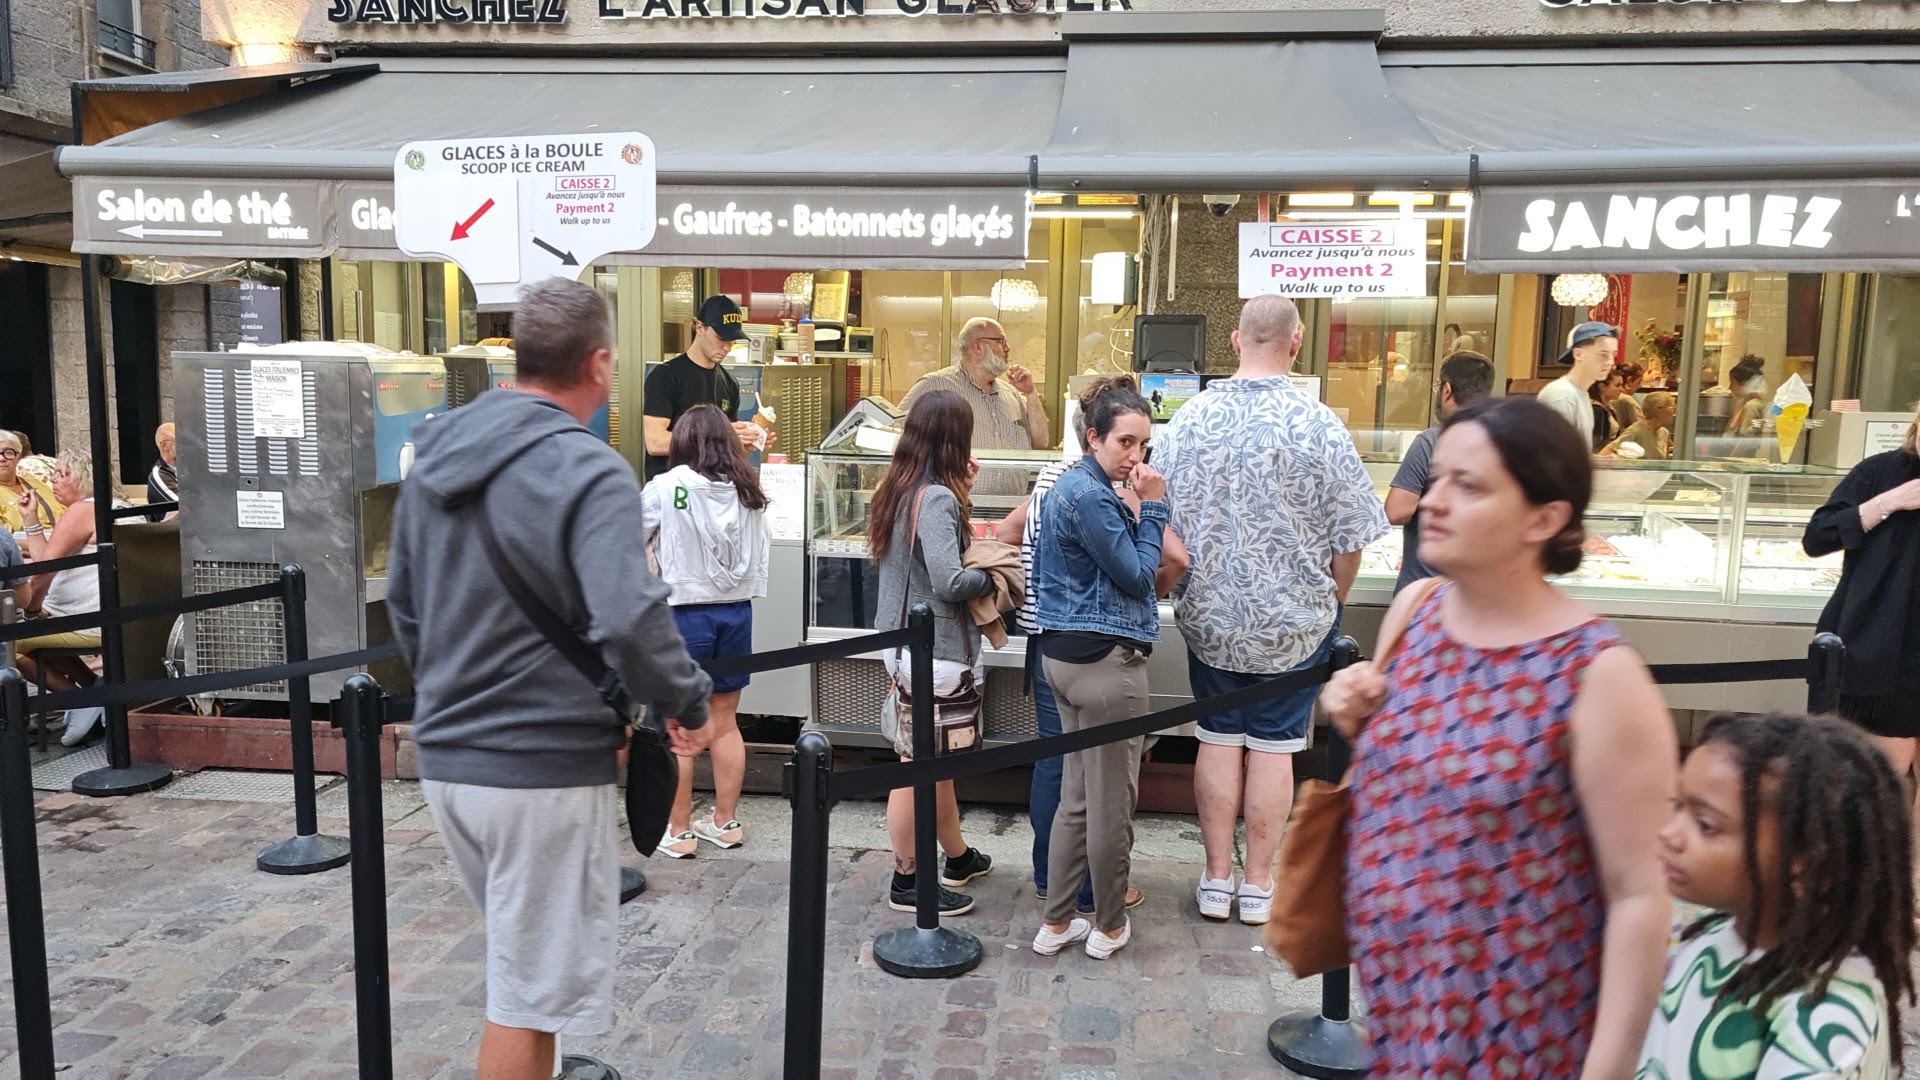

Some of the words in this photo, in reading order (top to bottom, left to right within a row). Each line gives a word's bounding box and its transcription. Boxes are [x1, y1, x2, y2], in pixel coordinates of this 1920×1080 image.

[328, 0, 567, 24] SANCHEZ
[599, 0, 865, 18] LARISAN
[442, 145, 505, 161] GLACES
[511, 145, 520, 159] à
[526, 144, 540, 159] la
[546, 143, 603, 158] BOULE
[461, 162, 507, 174] SCOOP
[511, 161, 532, 173] ICE
[535, 161, 585, 172] CREAM
[561, 178, 601, 189] CAISSE
[603, 178, 610, 188] 2
[546, 191, 577, 200] Avancez
[578, 190, 606, 200] jusqu'à
[607, 191, 625, 199] nous
[98, 189, 186, 222] Salon
[192, 190, 232, 223] de
[238, 191, 292, 224] thé
[556, 203, 605, 215] Payment
[608, 202, 615, 212] 2
[560, 217, 579, 225] Walk
[581, 218, 591, 226] up
[673, 202, 773, 235] Gaufres
[793, 204, 925, 238] Batonnets
[930, 204, 1014, 246] glaçés
[1517, 193, 1842, 252] SANCHEZ
[1280, 229, 1363, 244] CAISSE
[1370, 229, 1383, 243] 2
[1249, 248, 1313, 258] Avancez
[1316, 246, 1373, 260] jusqu'à
[1378, 248, 1415, 257] nous
[1271, 263, 1374, 281] Payment
[1381, 263, 1393, 277] 2
[1279, 283, 1318, 293] Walk
[1323, 285, 1343, 295] up
[1348, 284, 1363, 293] to
[1368, 285, 1385, 293] us
[253, 366, 271, 374] GLACES
[674, 485, 689, 510] B
[1206, 894, 1229, 904] adidas
[1240, 900, 1263, 909] adidas
